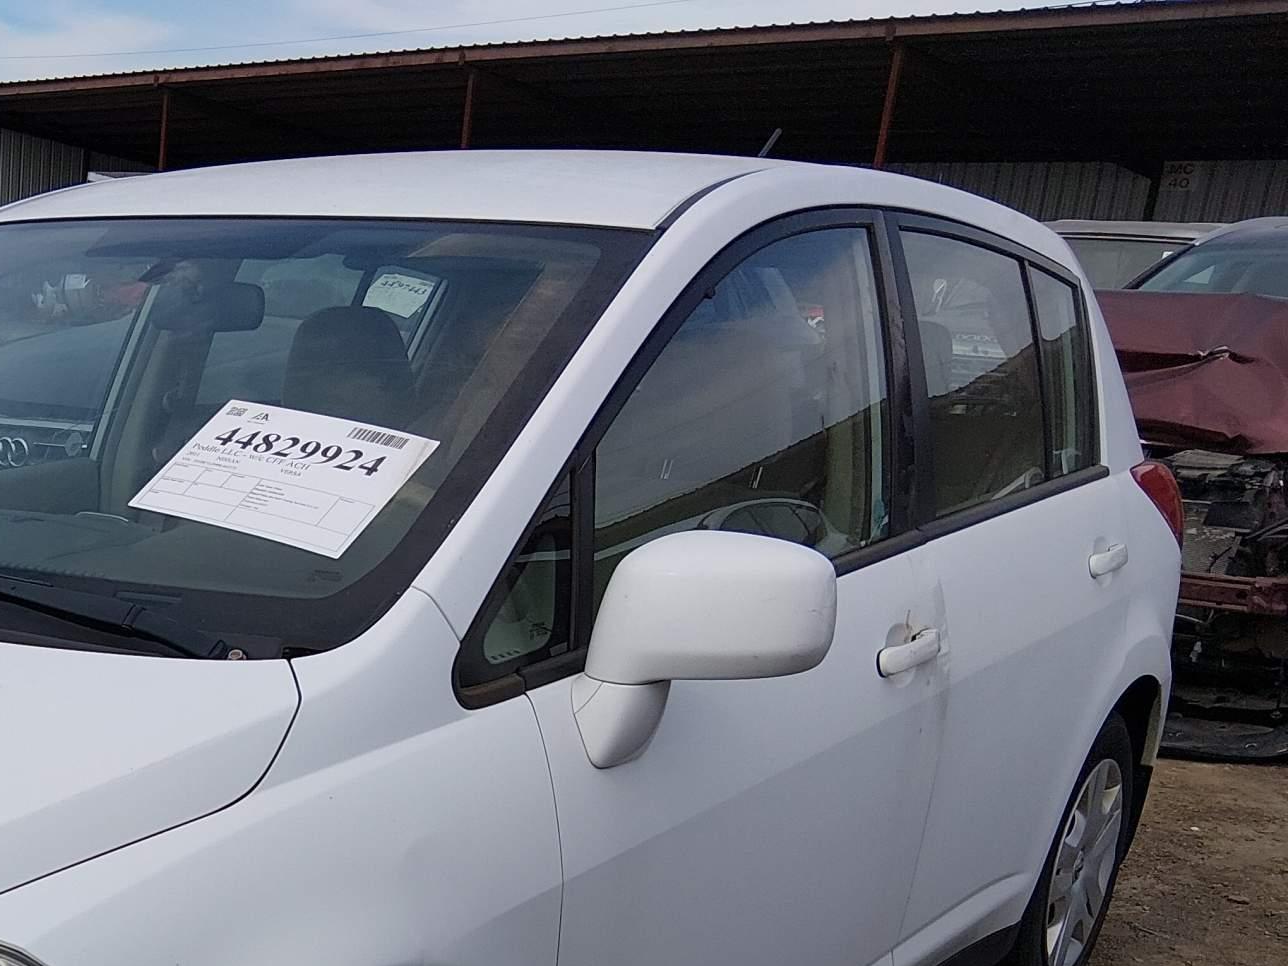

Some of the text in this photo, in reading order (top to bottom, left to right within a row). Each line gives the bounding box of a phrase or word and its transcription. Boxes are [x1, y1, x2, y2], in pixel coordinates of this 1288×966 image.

[215, 427, 387, 477] 44829924
[221, 447, 243, 457] LLC
[286, 459, 312, 470] ACH
